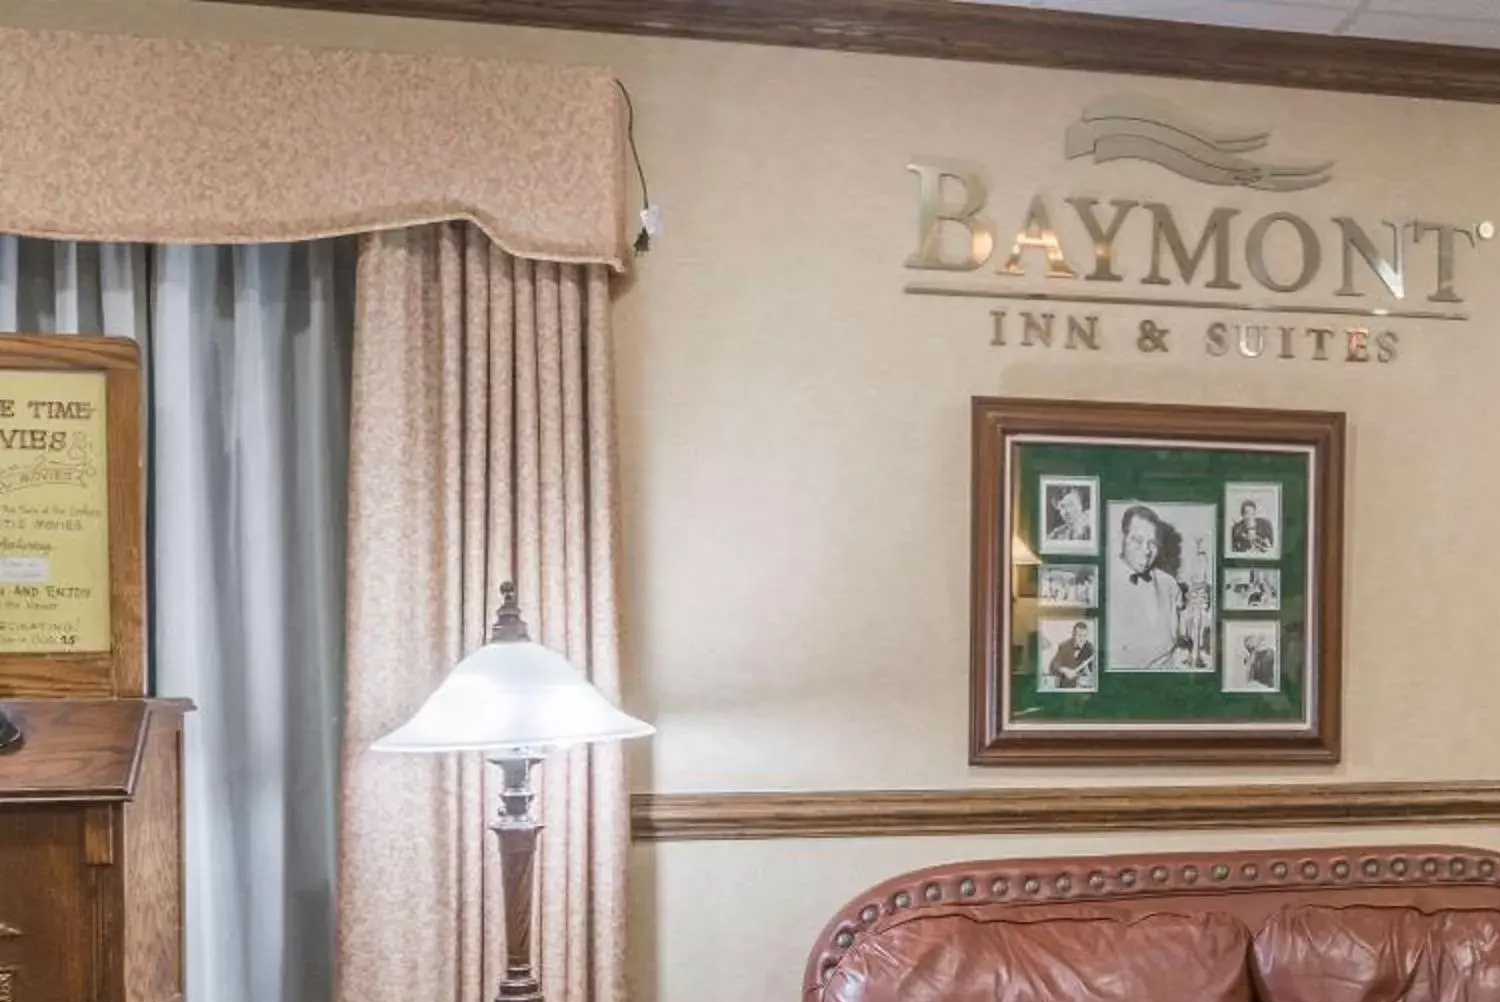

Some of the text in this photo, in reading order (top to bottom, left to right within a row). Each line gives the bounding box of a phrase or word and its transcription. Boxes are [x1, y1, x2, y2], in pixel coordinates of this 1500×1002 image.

[904, 162, 1476, 303] BAYMONT
[989, 309, 1400, 363] INN & SUITES
[27, 400, 97, 420] TIME
